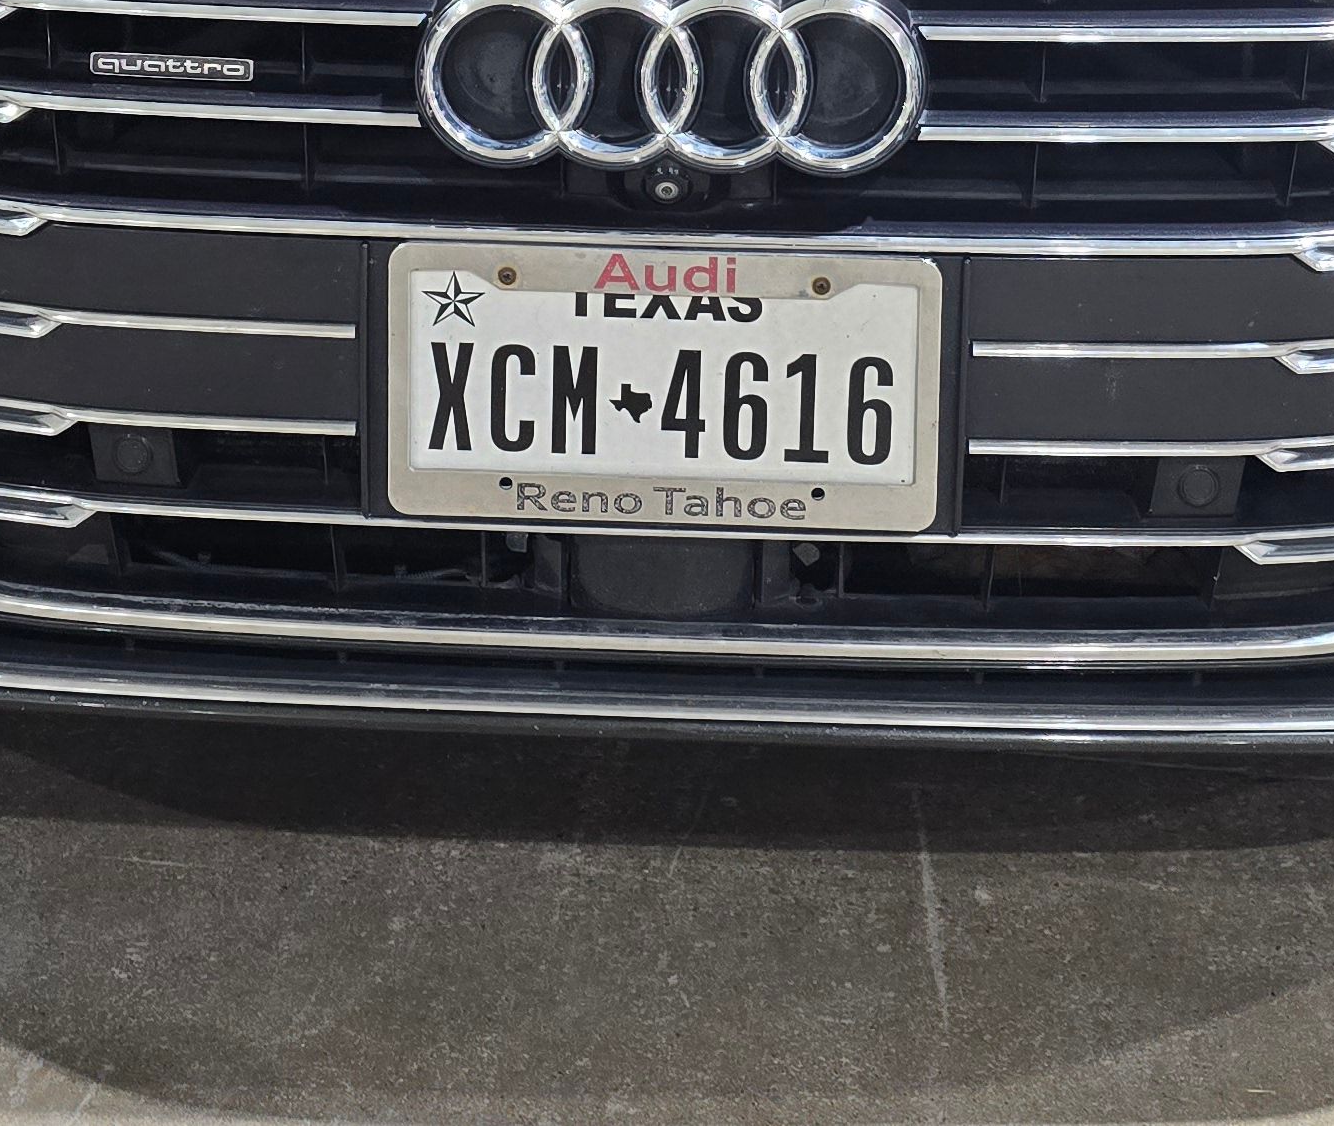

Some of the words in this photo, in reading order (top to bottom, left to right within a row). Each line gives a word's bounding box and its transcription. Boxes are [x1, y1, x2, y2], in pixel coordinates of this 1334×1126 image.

[98, 57, 245, 76] quattro
[594, 253, 737, 294] Audi
[428, 341, 598, 455] XCM
[660, 349, 894, 465] 4616
[515, 482, 643, 515] Reno
[652, 486, 807, 520] Tahoe
